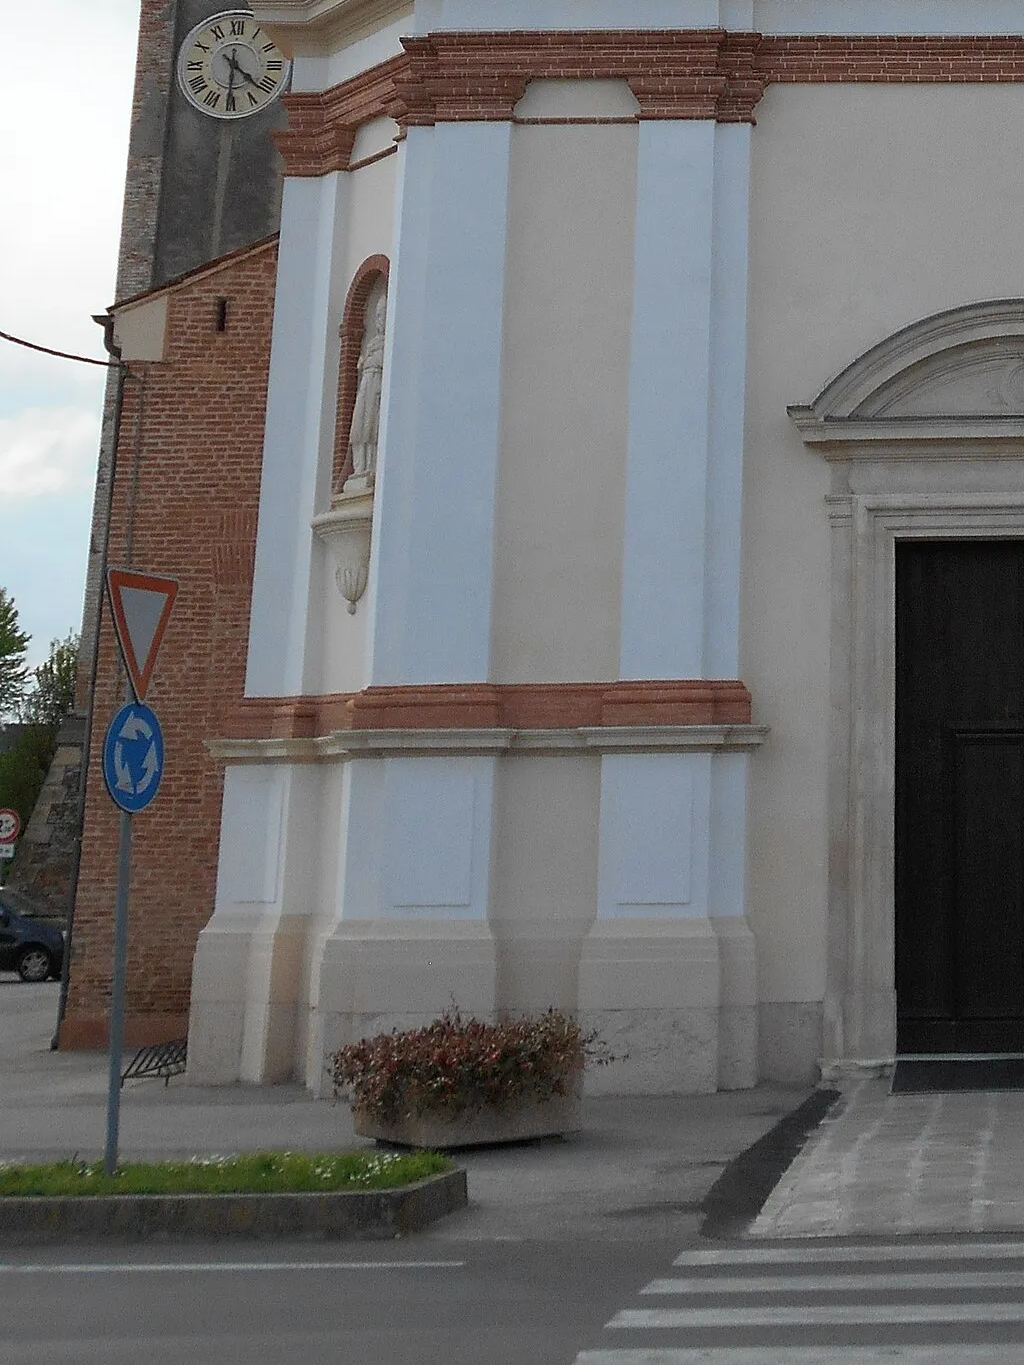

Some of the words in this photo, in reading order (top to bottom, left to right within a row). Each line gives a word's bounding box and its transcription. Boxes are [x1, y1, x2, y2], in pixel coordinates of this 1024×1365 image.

[210, 25, 225, 42] XI
[230, 21, 244, 35] XII
[194, 41, 210, 53] X
[262, 42, 276, 52] II
[187, 60, 203, 70] IX
[266, 60, 282, 70] III
[247, 92, 258, 106] V
